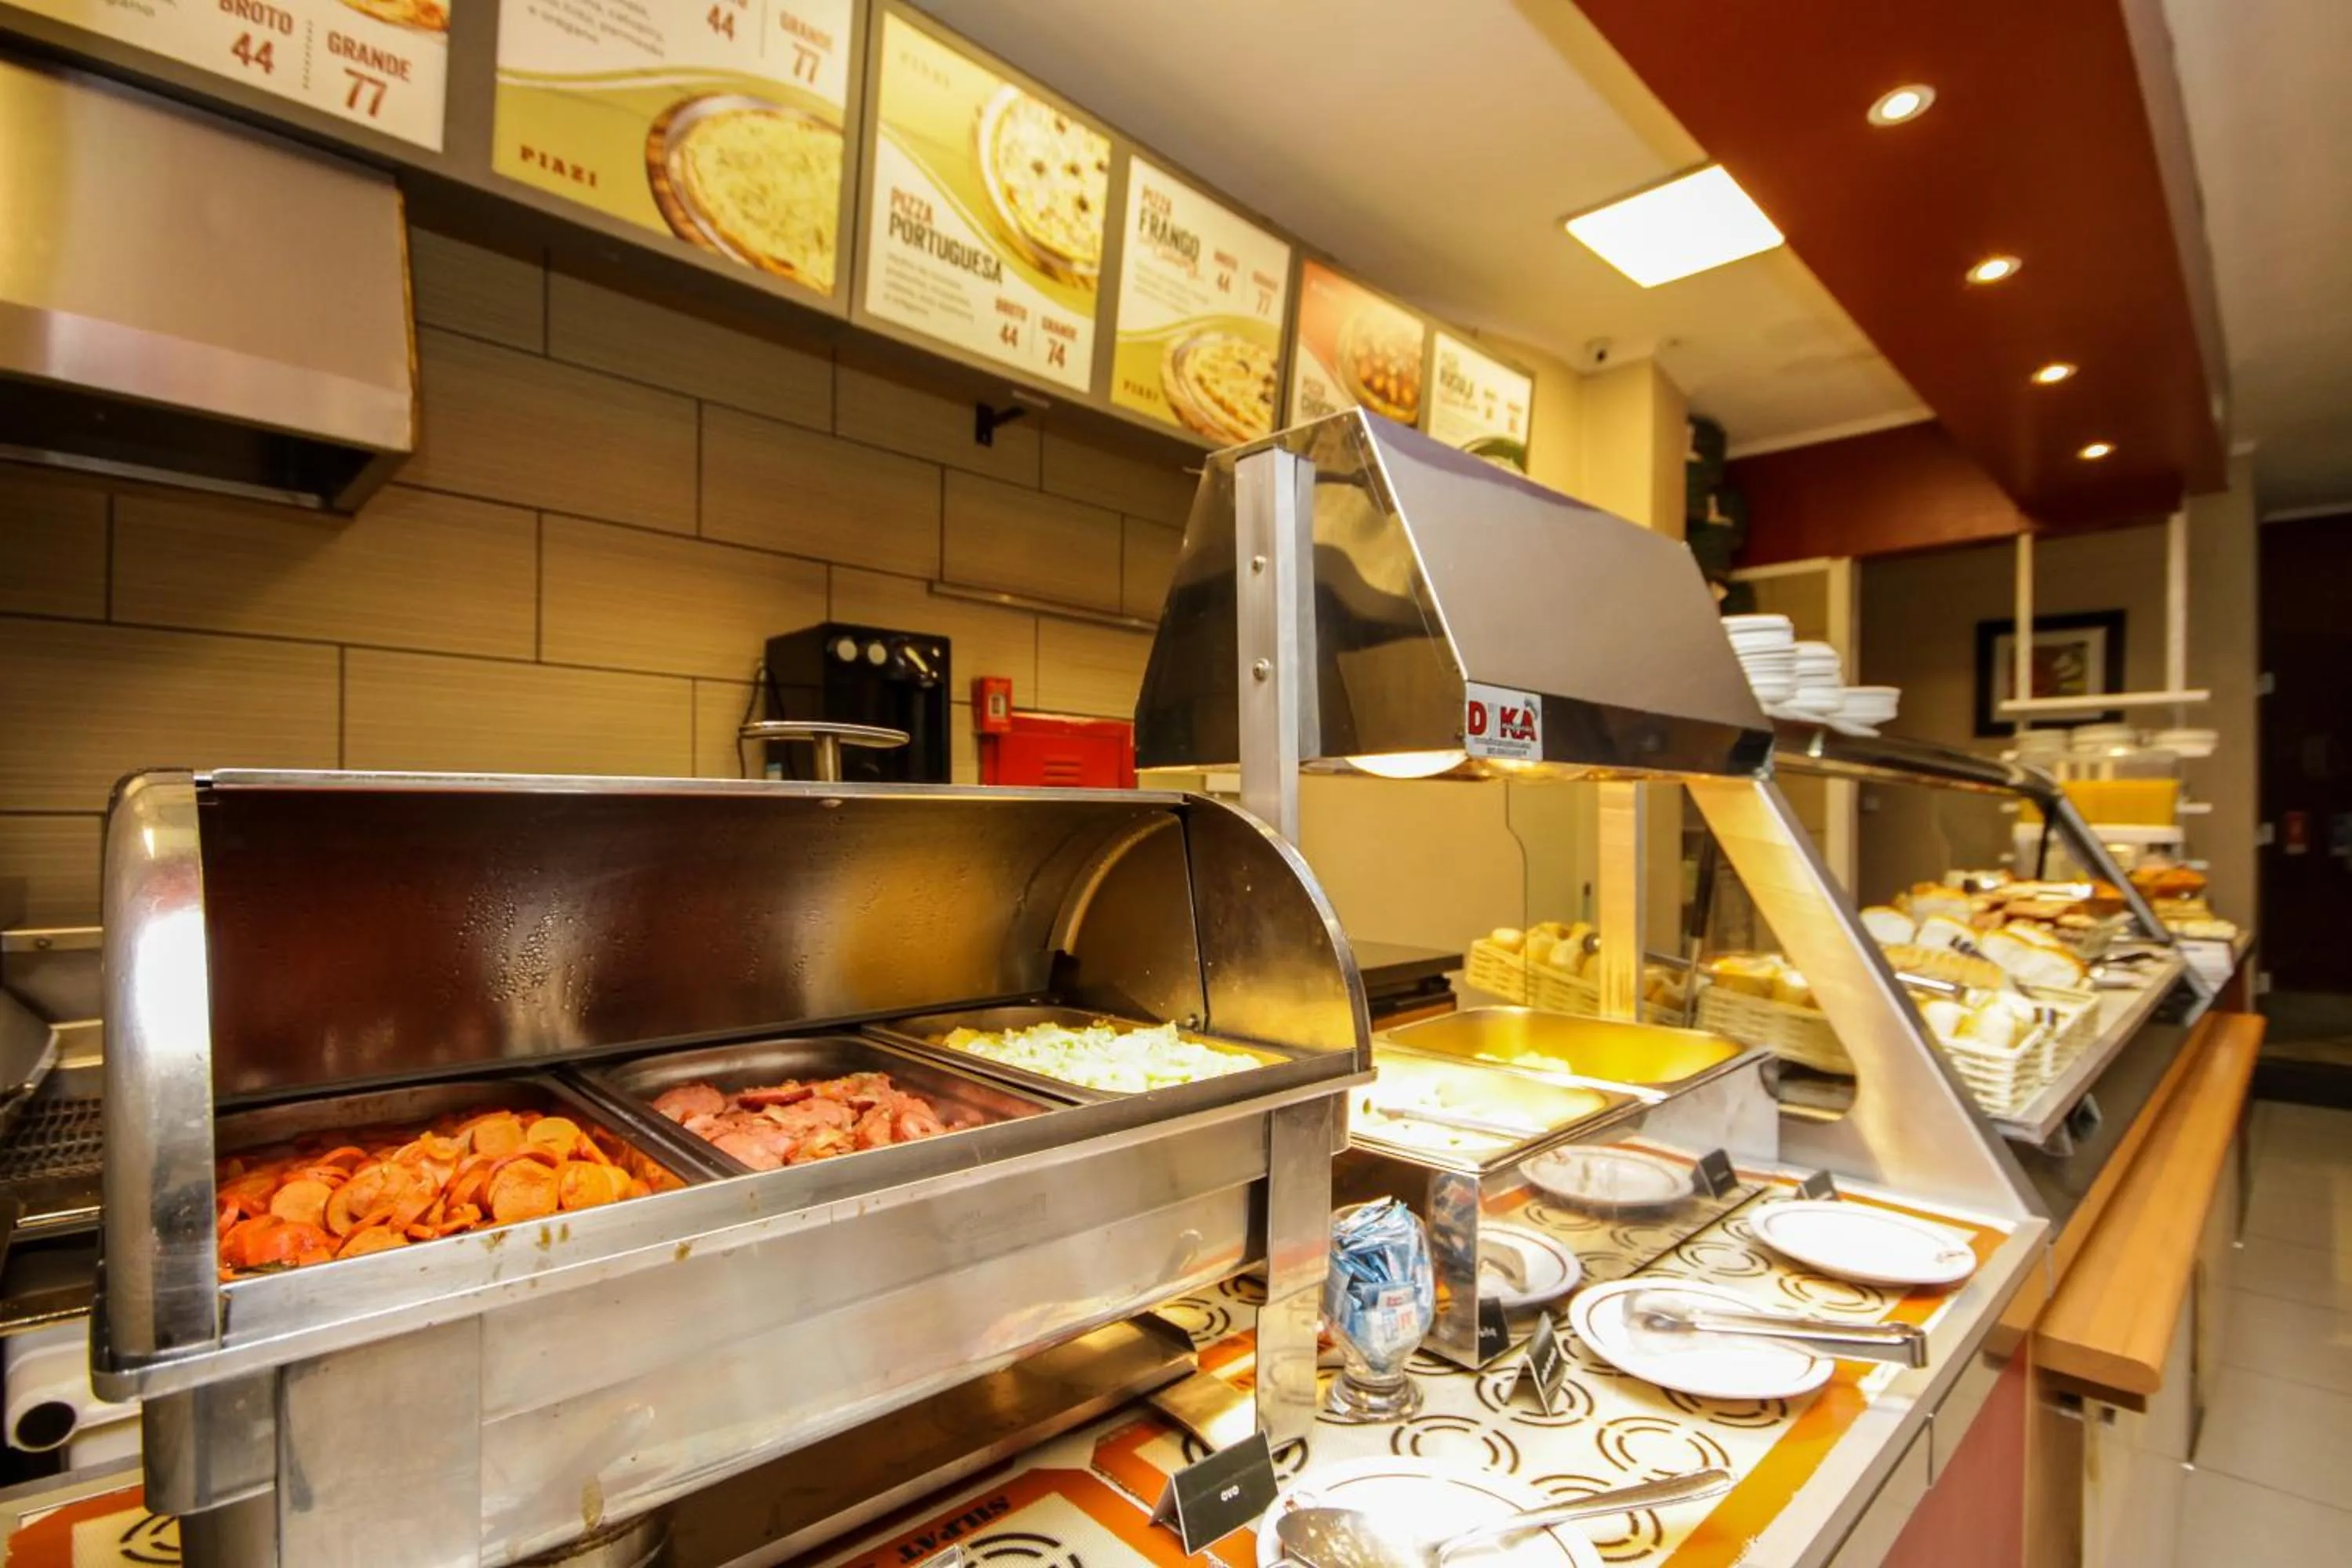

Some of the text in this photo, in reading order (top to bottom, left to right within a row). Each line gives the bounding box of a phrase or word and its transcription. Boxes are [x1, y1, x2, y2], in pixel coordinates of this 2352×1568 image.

[706, 4, 735, 42] 44
[231, 32, 274, 74] 44
[328, 31, 413, 83] GRANDE
[793, 42, 820, 85] 77
[344, 67, 388, 118] 77
[889, 212, 1003, 285] PORTUGUESA
[1139, 207, 1200, 263] FRANGO
[1048, 337, 1065, 369] 74
[898, 1496, 1011, 1563] SILPAT
